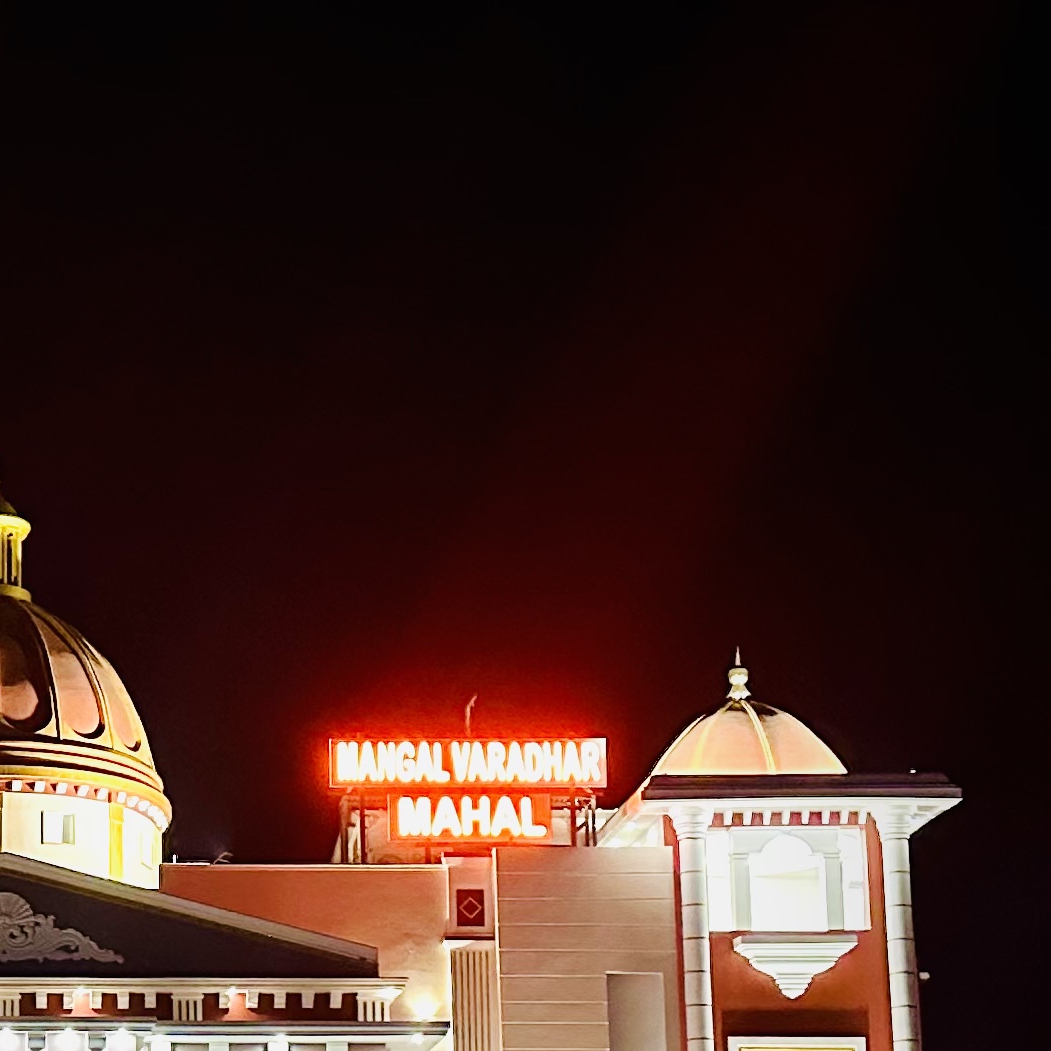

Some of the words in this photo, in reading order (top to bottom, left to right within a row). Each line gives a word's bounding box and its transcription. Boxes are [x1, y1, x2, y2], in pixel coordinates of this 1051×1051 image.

[336, 740, 451, 782] MANGAL
[451, 741, 601, 782] VARADHAR
[397, 795, 548, 837] MAHAL
